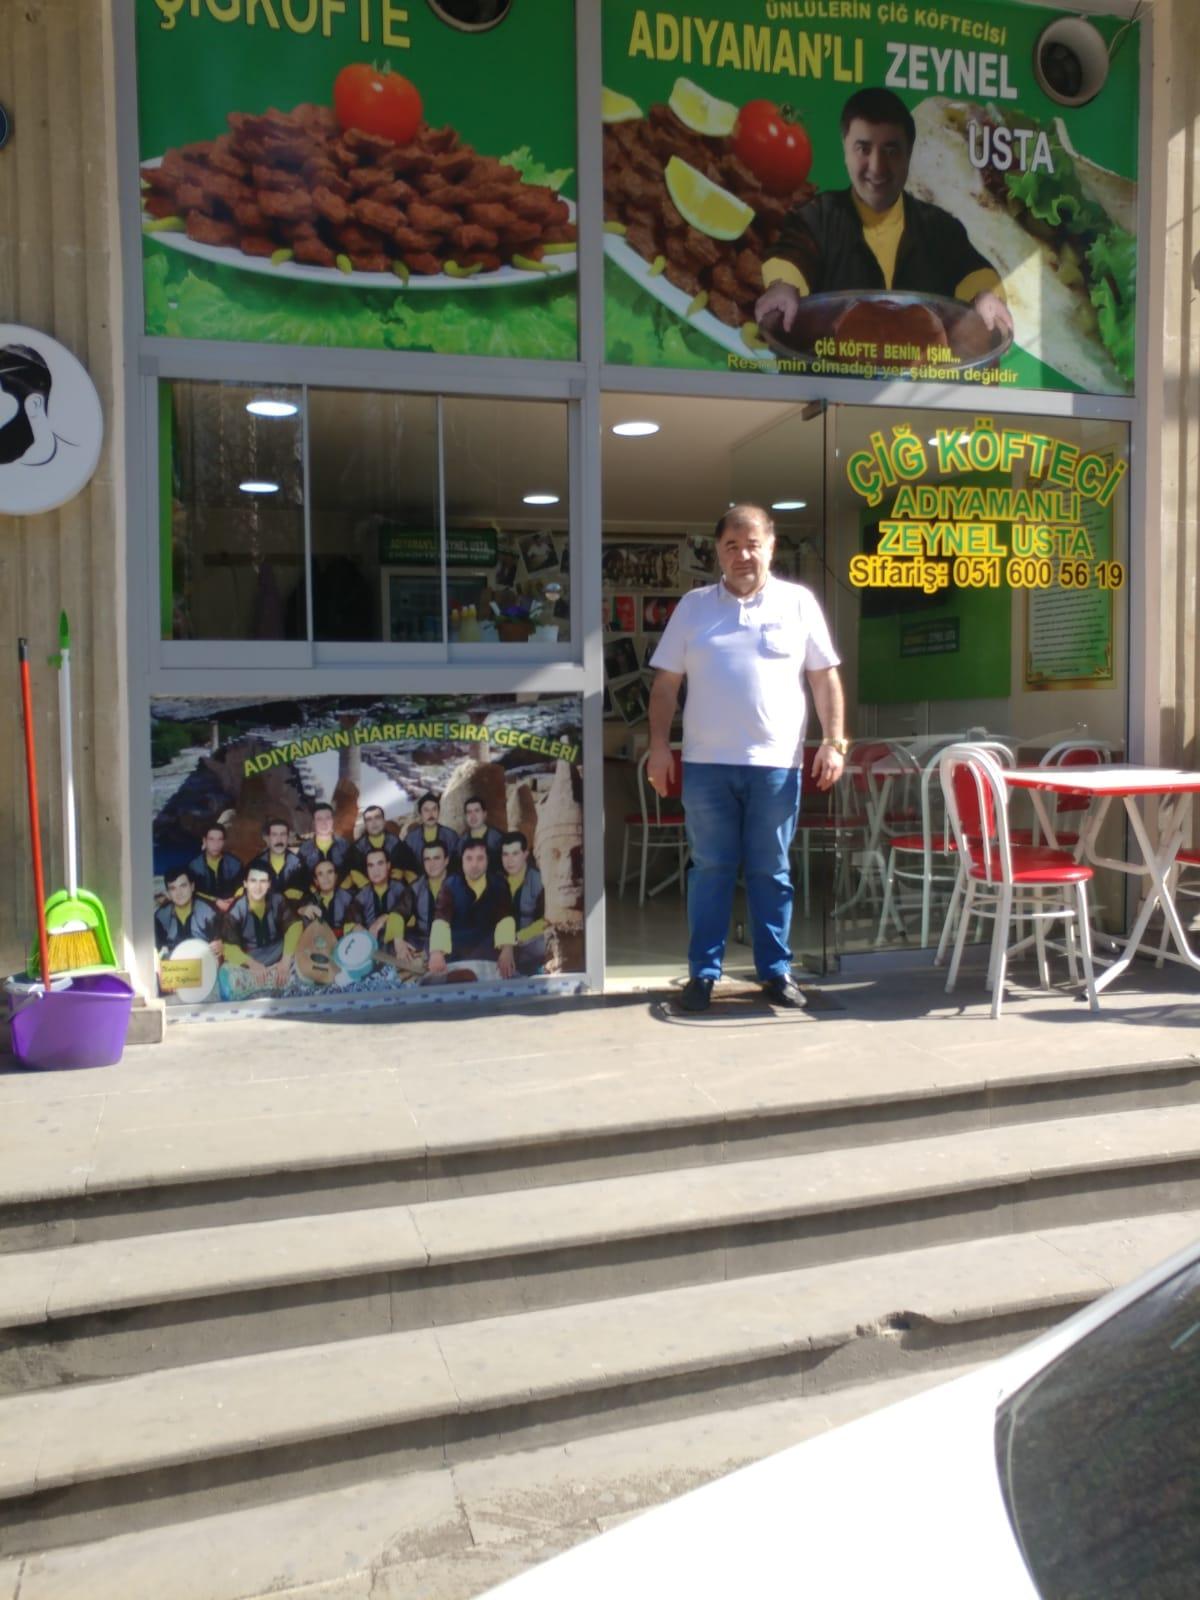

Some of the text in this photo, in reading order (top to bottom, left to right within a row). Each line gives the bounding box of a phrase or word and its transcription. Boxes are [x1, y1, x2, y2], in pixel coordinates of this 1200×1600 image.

[877, 2, 909, 25] ÇİĞ
[914, 8, 1007, 47] KÖFTECİSİ
[628, 10, 1018, 99] ADIYAMAN'LI ZEYNEL
[968, 125, 1055, 174] USTA
[839, 340, 878, 359] KÖFTE
[883, 342, 921, 361] BENİM
[963, 368, 1018, 385] değildir
[847, 417, 1128, 507] ÇİĞ KÖFTECİ
[891, 485, 1081, 523] ADIYAMANLI
[877, 521, 1094, 560] ZEYNEL USTA
[849, 555, 1123, 594] Sifariş: 051 600 56 19
[243, 730, 350, 777] ADIYAMAN
[353, 722, 444, 745] HARFANE
[448, 722, 490, 742] SIRA
